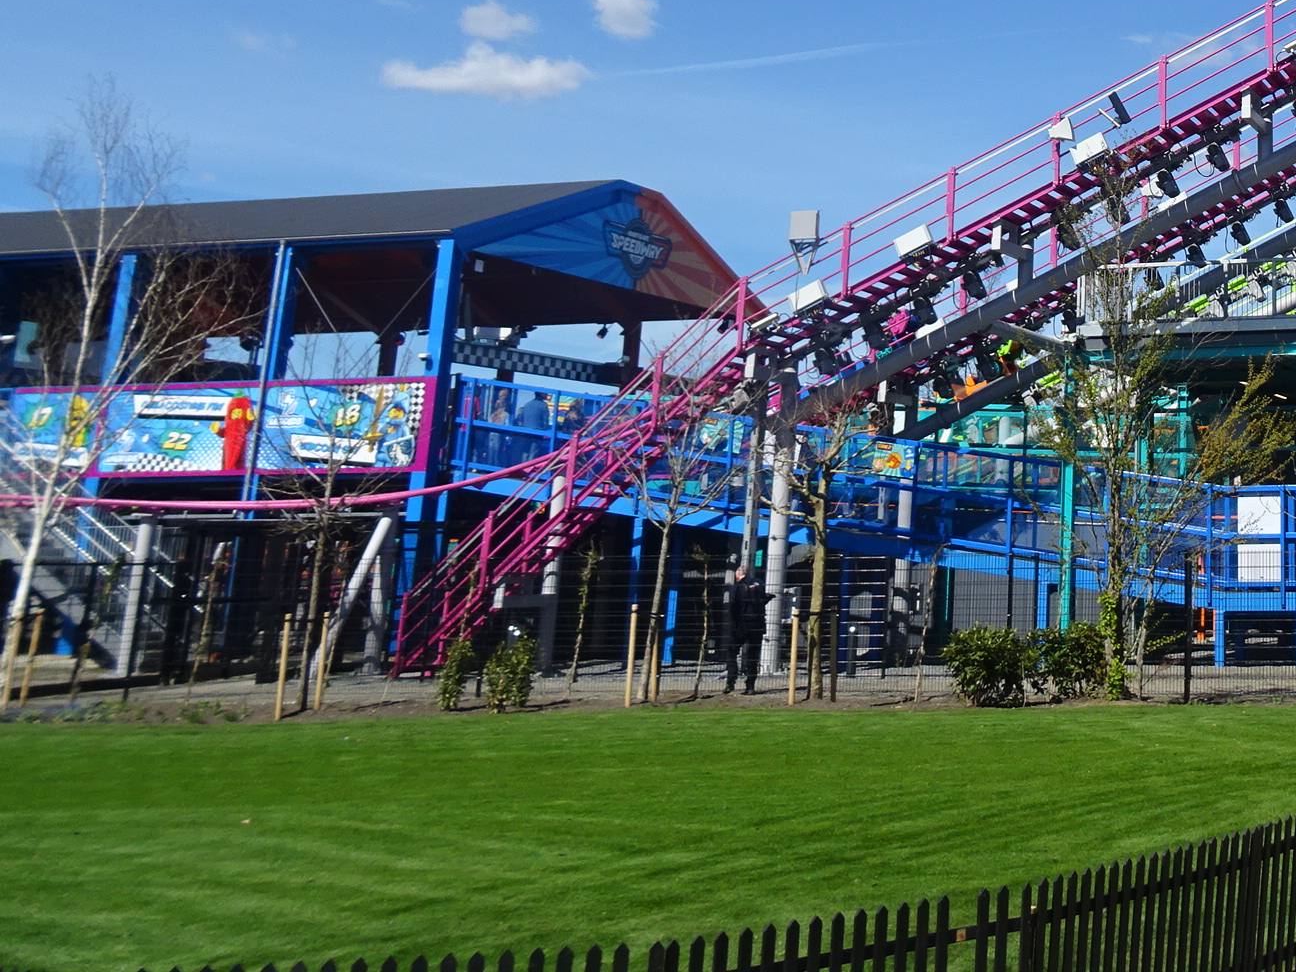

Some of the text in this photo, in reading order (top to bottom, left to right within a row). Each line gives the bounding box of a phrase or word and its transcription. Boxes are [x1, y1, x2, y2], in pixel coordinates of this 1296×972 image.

[610, 231, 665, 260] SPEEDWAY
[335, 404, 361, 427] 18
[161, 431, 192, 451] 22
